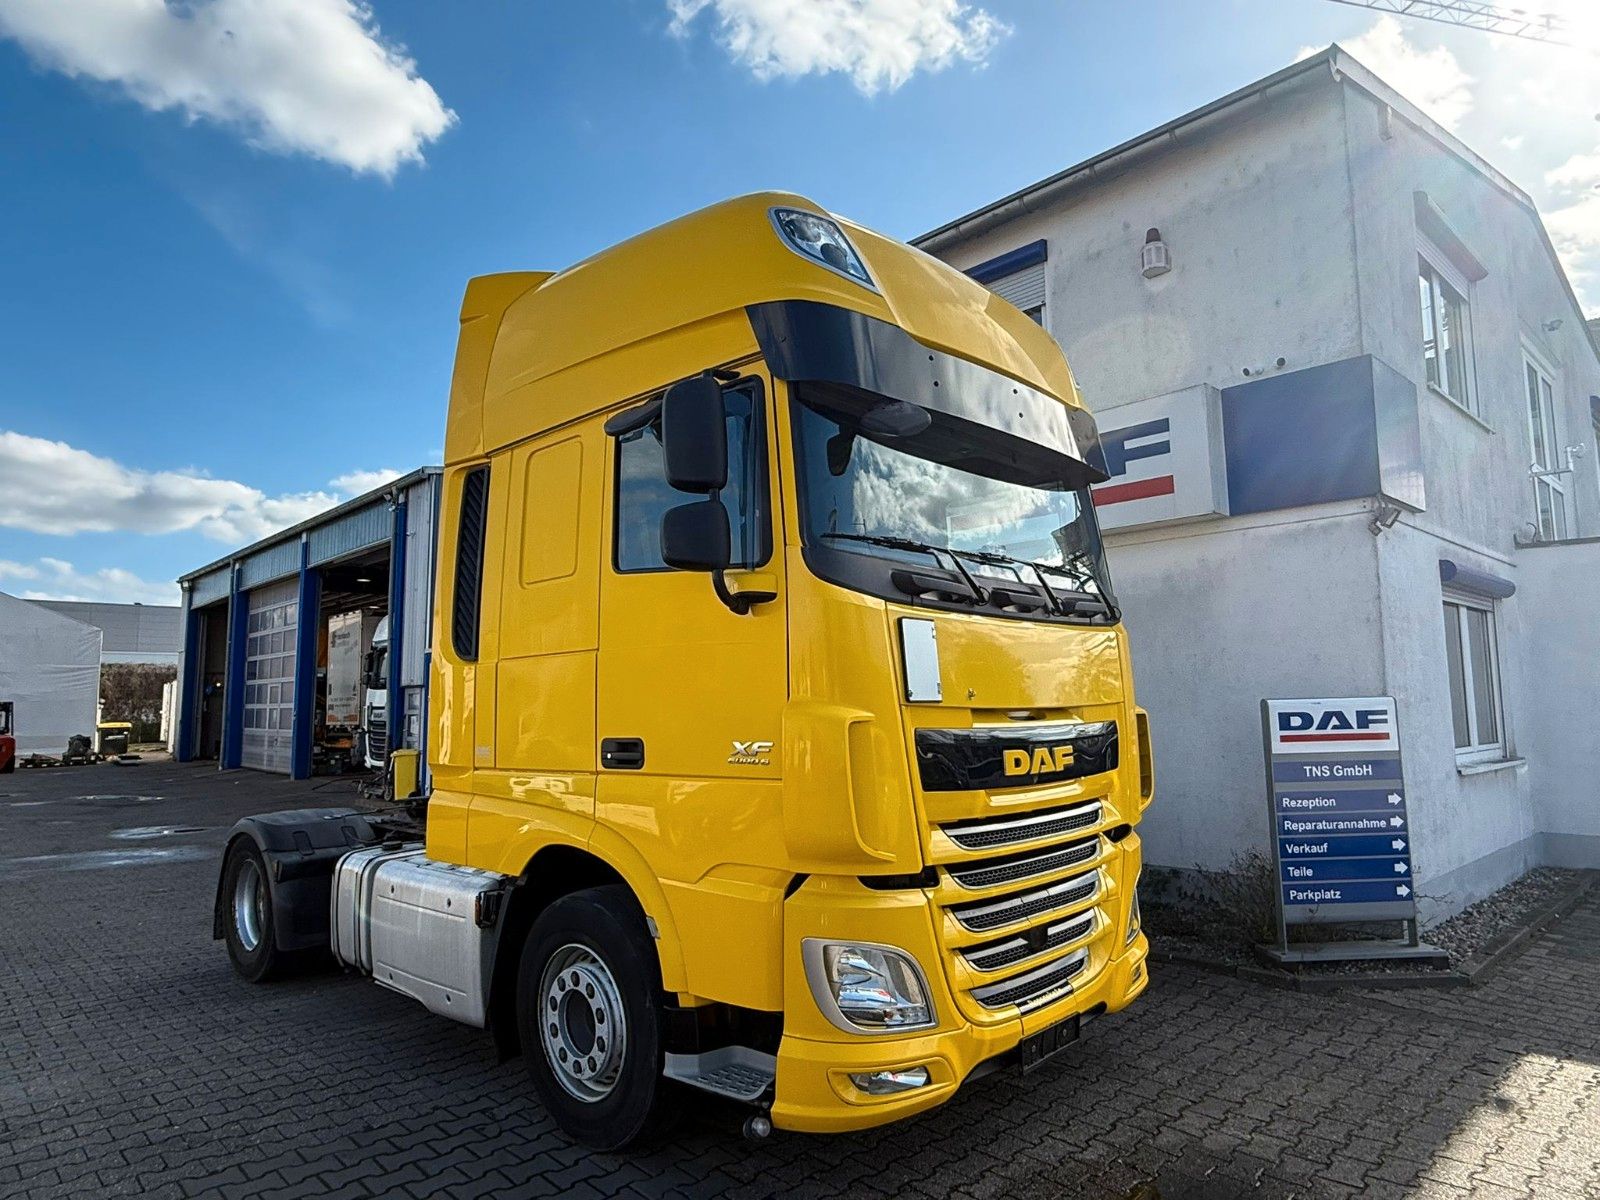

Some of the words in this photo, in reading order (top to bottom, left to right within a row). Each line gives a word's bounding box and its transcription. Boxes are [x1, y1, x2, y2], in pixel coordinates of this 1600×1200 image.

[1278, 709, 1388, 731] DAF
[730, 740, 775, 756] XF
[1002, 745, 1075, 776] DAF
[1304, 765, 1330, 777] TNS
[1333, 764, 1373, 776] GmbH
[1282, 796, 1337, 809] Rezeption
[1284, 819, 1387, 832] Reparaturannahme
[1285, 842, 1329, 854] Verkauf
[1287, 866, 1314, 877] Teile
[1289, 889, 1342, 902] Parkplatz
